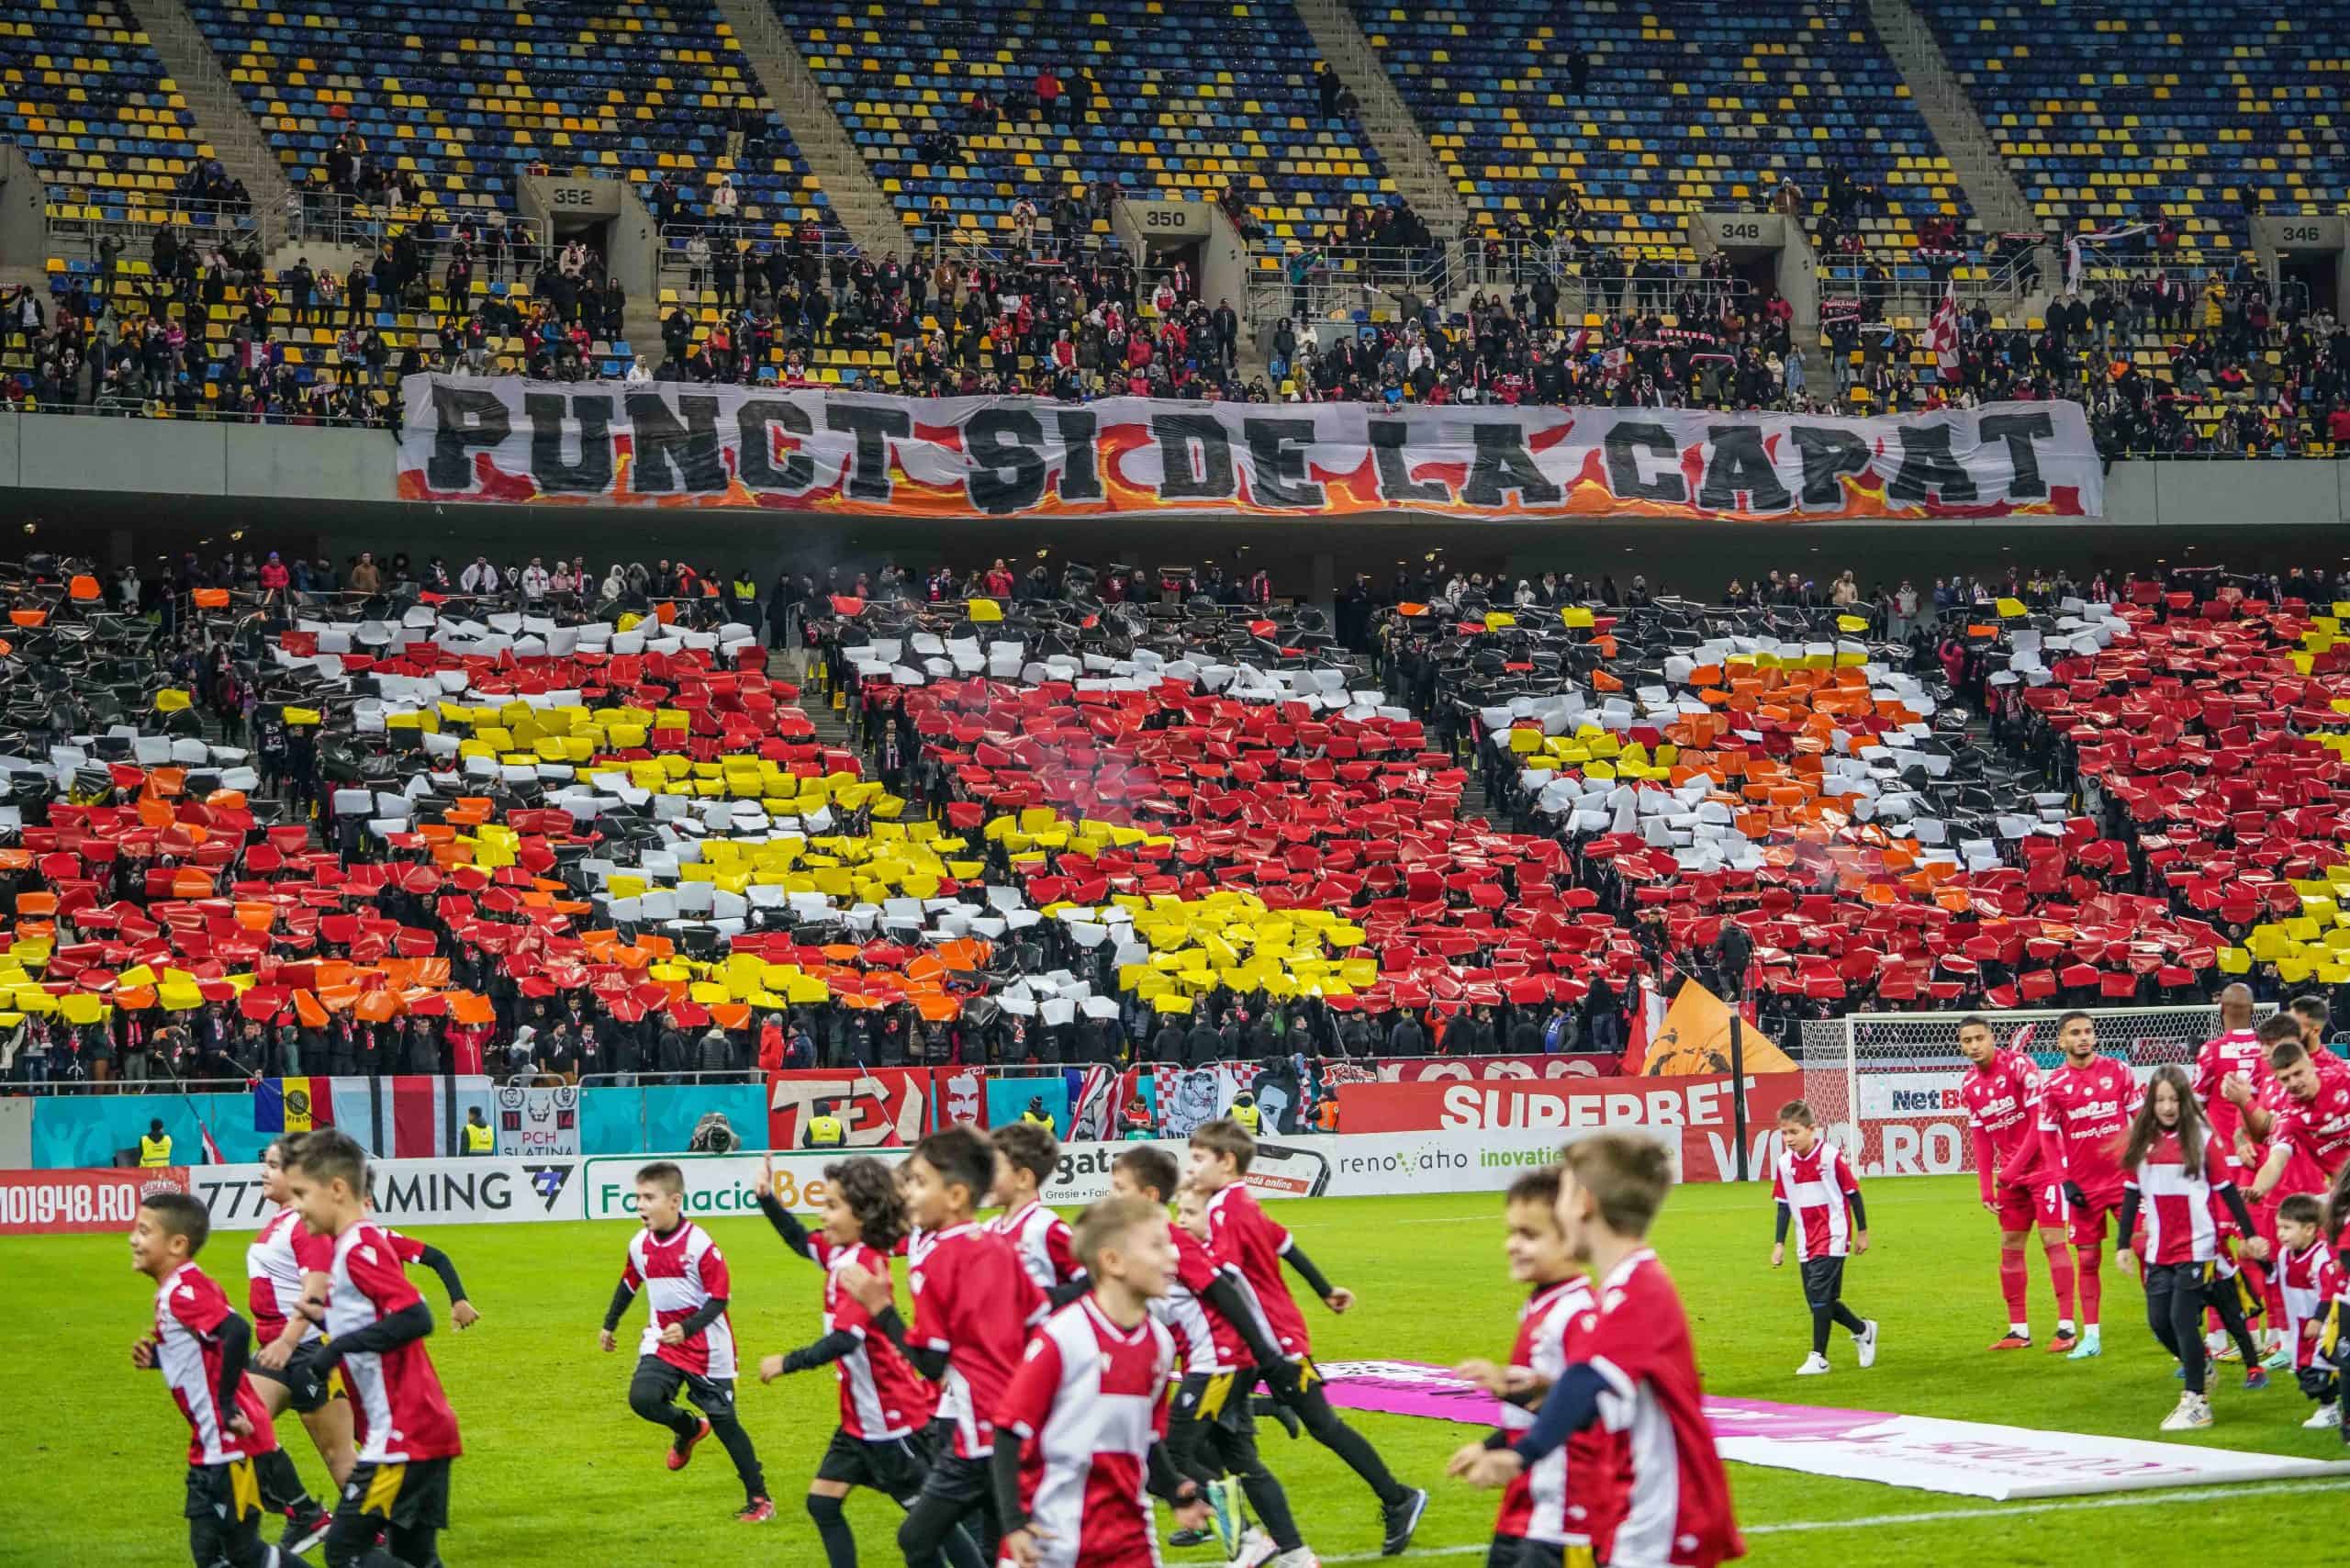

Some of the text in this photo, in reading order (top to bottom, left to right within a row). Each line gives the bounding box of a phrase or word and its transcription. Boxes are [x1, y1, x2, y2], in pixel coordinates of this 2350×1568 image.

[554, 188, 593, 205] 352
[1147, 211, 1185, 227] 350
[1722, 224, 1759, 239] 348
[2283, 227, 2320, 241] 346
[428, 384, 912, 500] PUNCT
[1152, 413, 1325, 507] DE
[1368, 419, 1565, 507] LA
[1603, 411, 2055, 510] CAPAT
[1893, 1089, 1969, 1110] NetB
[522, 1130, 557, 1145] PCH
[601, 1181, 759, 1214] Faacia
[1046, 1190, 1080, 1199] Gresie
[2043, 1185, 2056, 1204] 4
